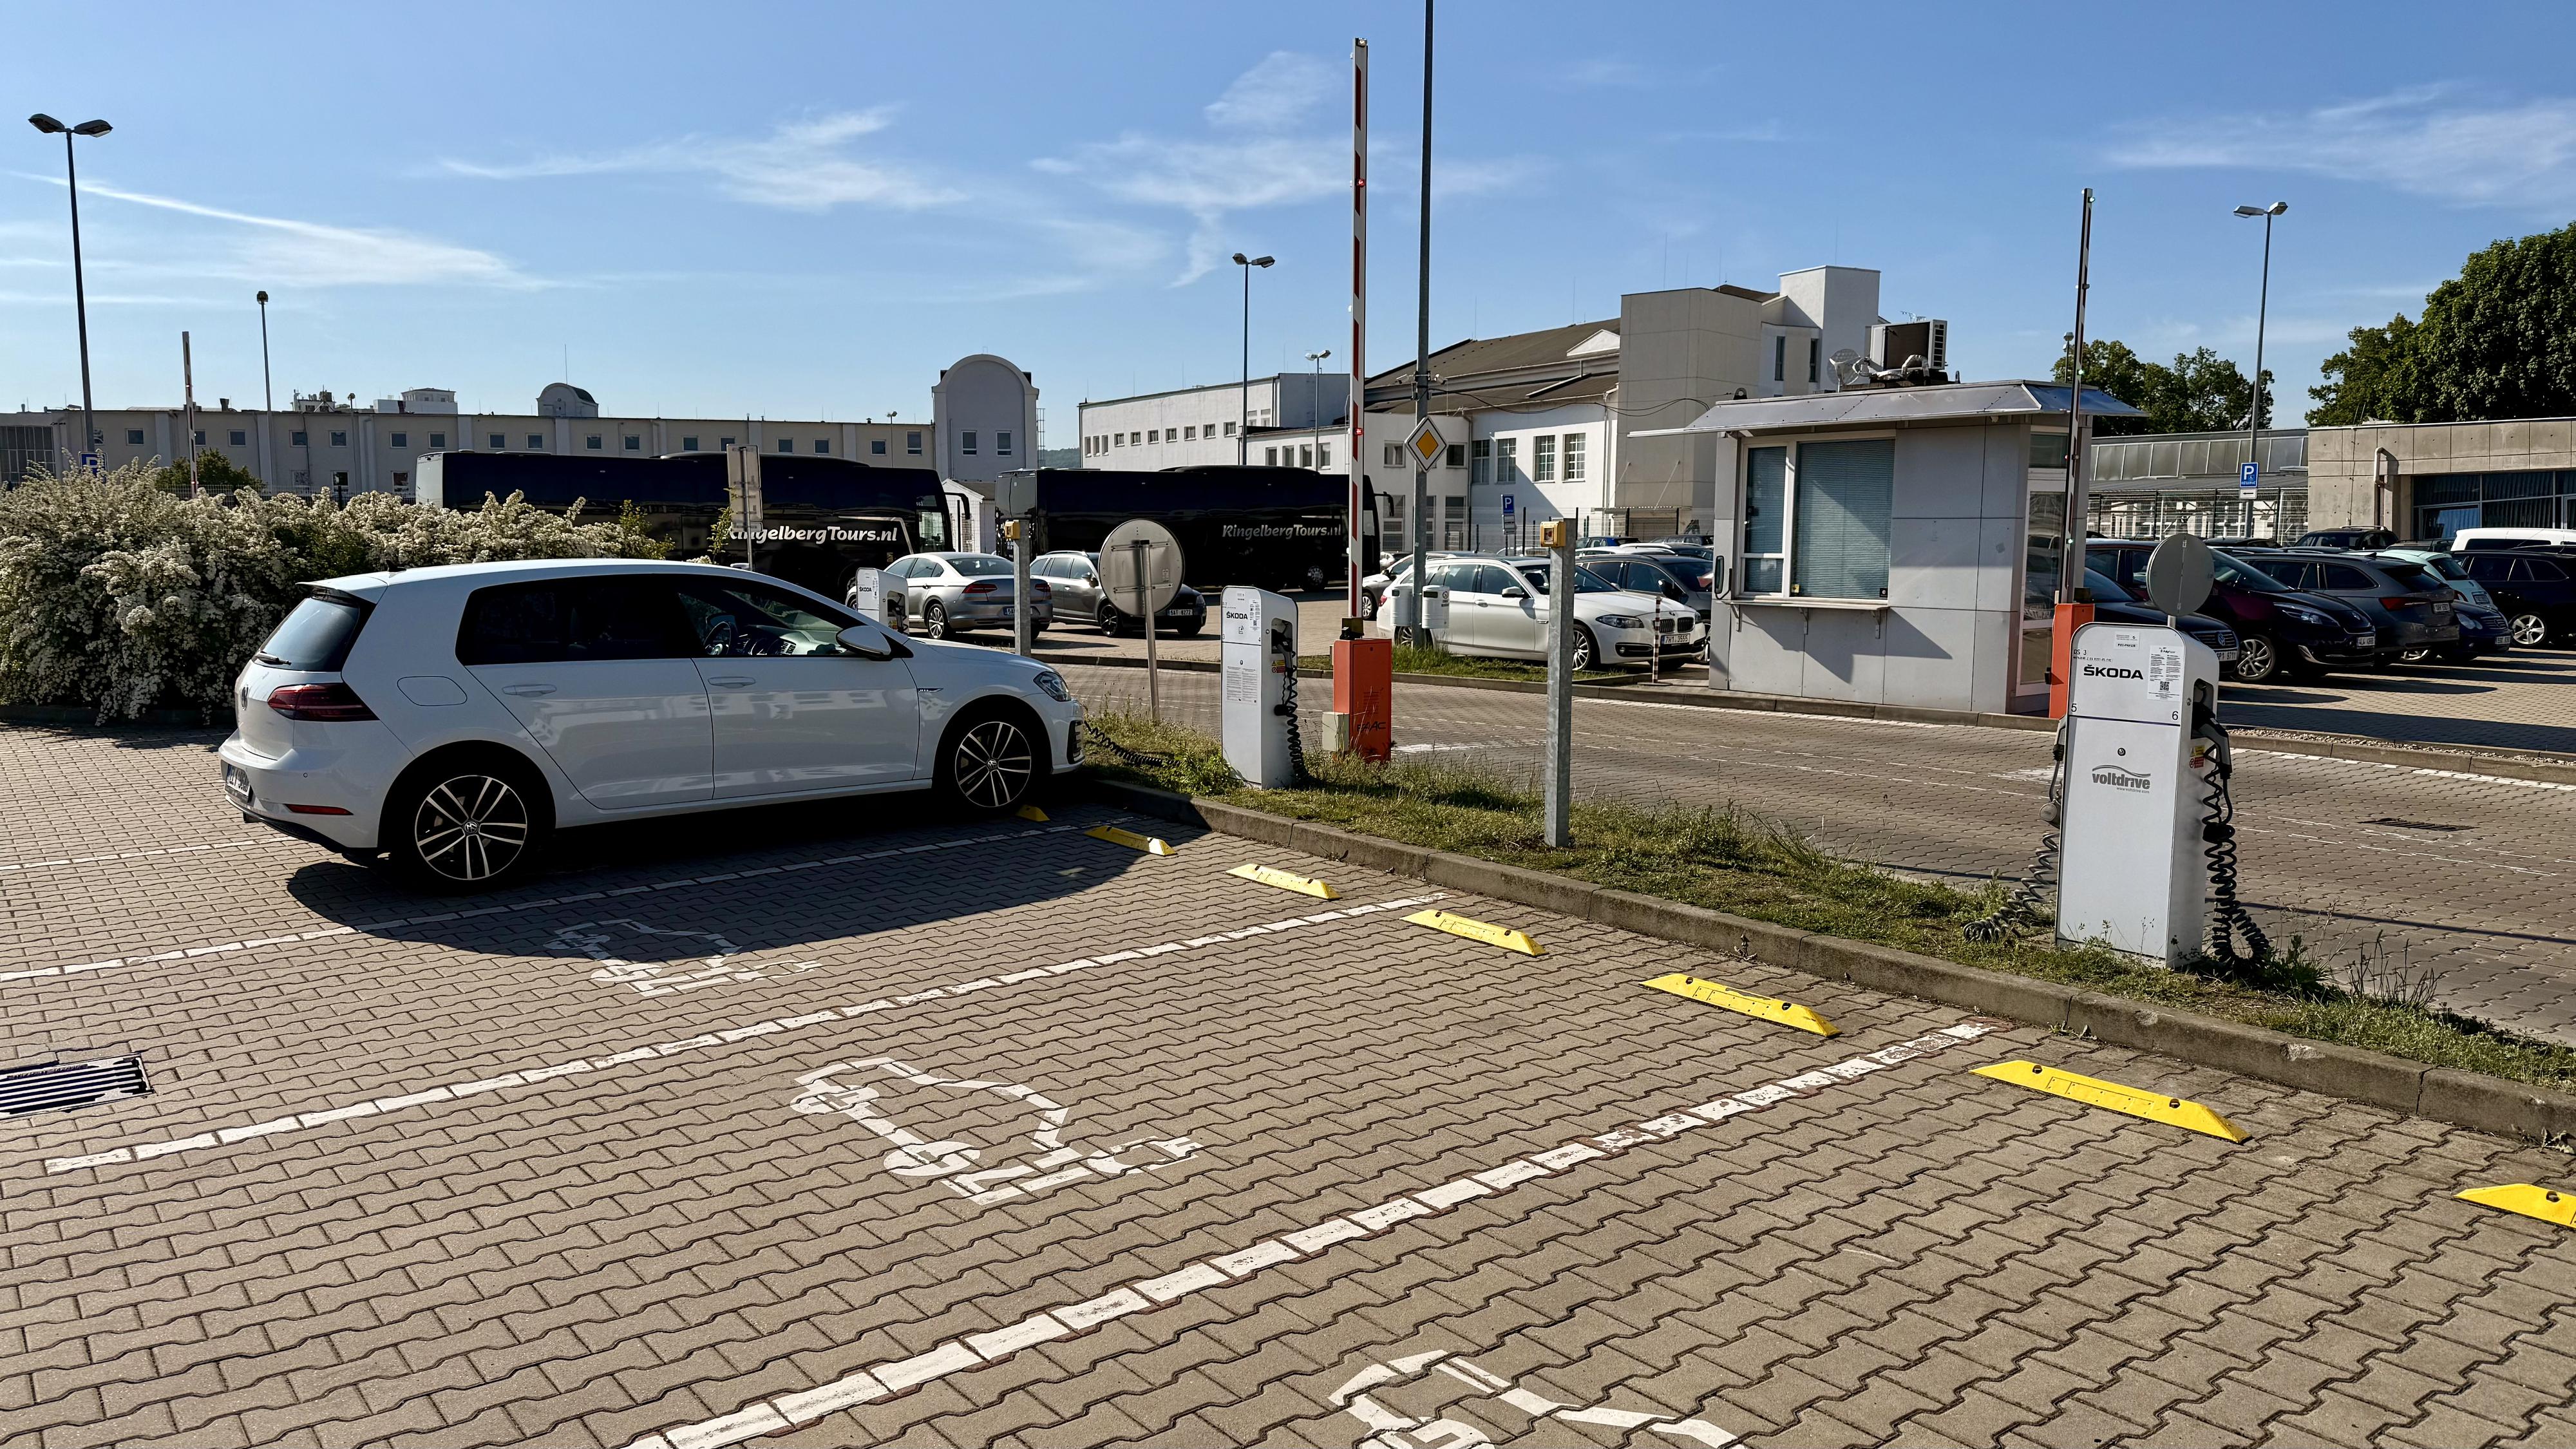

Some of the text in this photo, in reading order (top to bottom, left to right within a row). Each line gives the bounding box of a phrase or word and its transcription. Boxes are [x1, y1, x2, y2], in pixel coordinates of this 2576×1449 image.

[2244, 466, 2255, 480] P
[1504, 497, 1512, 509] P
[1222, 524, 1341, 540] RingelbergTours.nl
[1226, 611, 1248, 620] ŠKODA
[2083, 664, 2144, 680] ŠKODA
[2071, 703, 2078, 712] 5
[2172, 710, 2179, 721] 6
[2092, 772, 2151, 790] voltdrive
